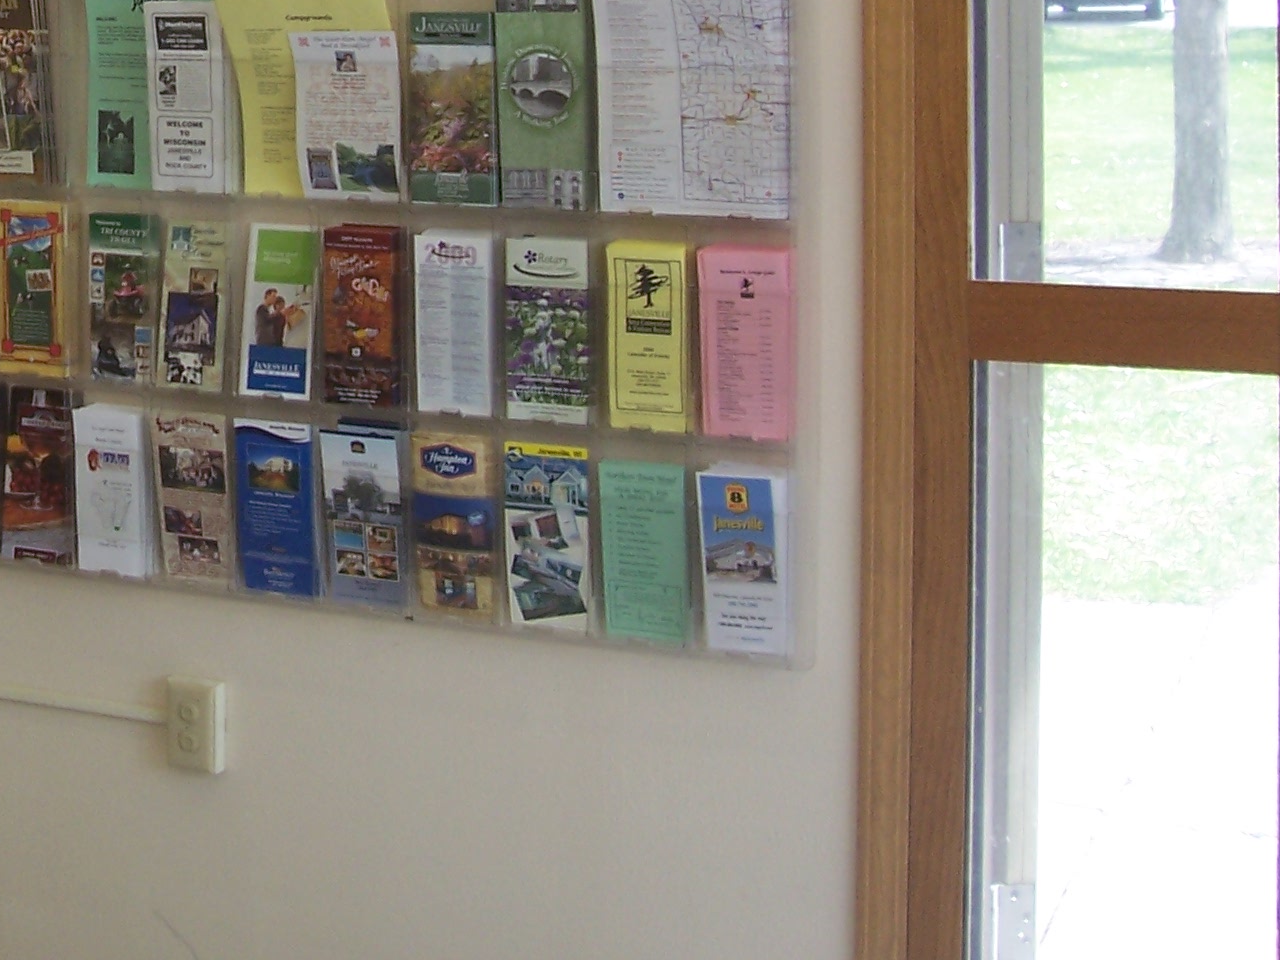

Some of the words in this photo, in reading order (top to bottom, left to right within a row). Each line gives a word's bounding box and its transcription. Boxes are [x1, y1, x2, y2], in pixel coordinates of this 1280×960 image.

[415, 16, 482, 33] JANESVILLE
[166, 120, 203, 129] WELCOME
[179, 129, 190, 137] TO
[163, 138, 206, 147] WISCONSIN
[424, 241, 478, 267] 2009
[537, 252, 568, 267] Rotary
[428, 451, 469, 466] Hampton
[439, 463, 455, 474] Inn
[730, 492, 743, 503] 8
